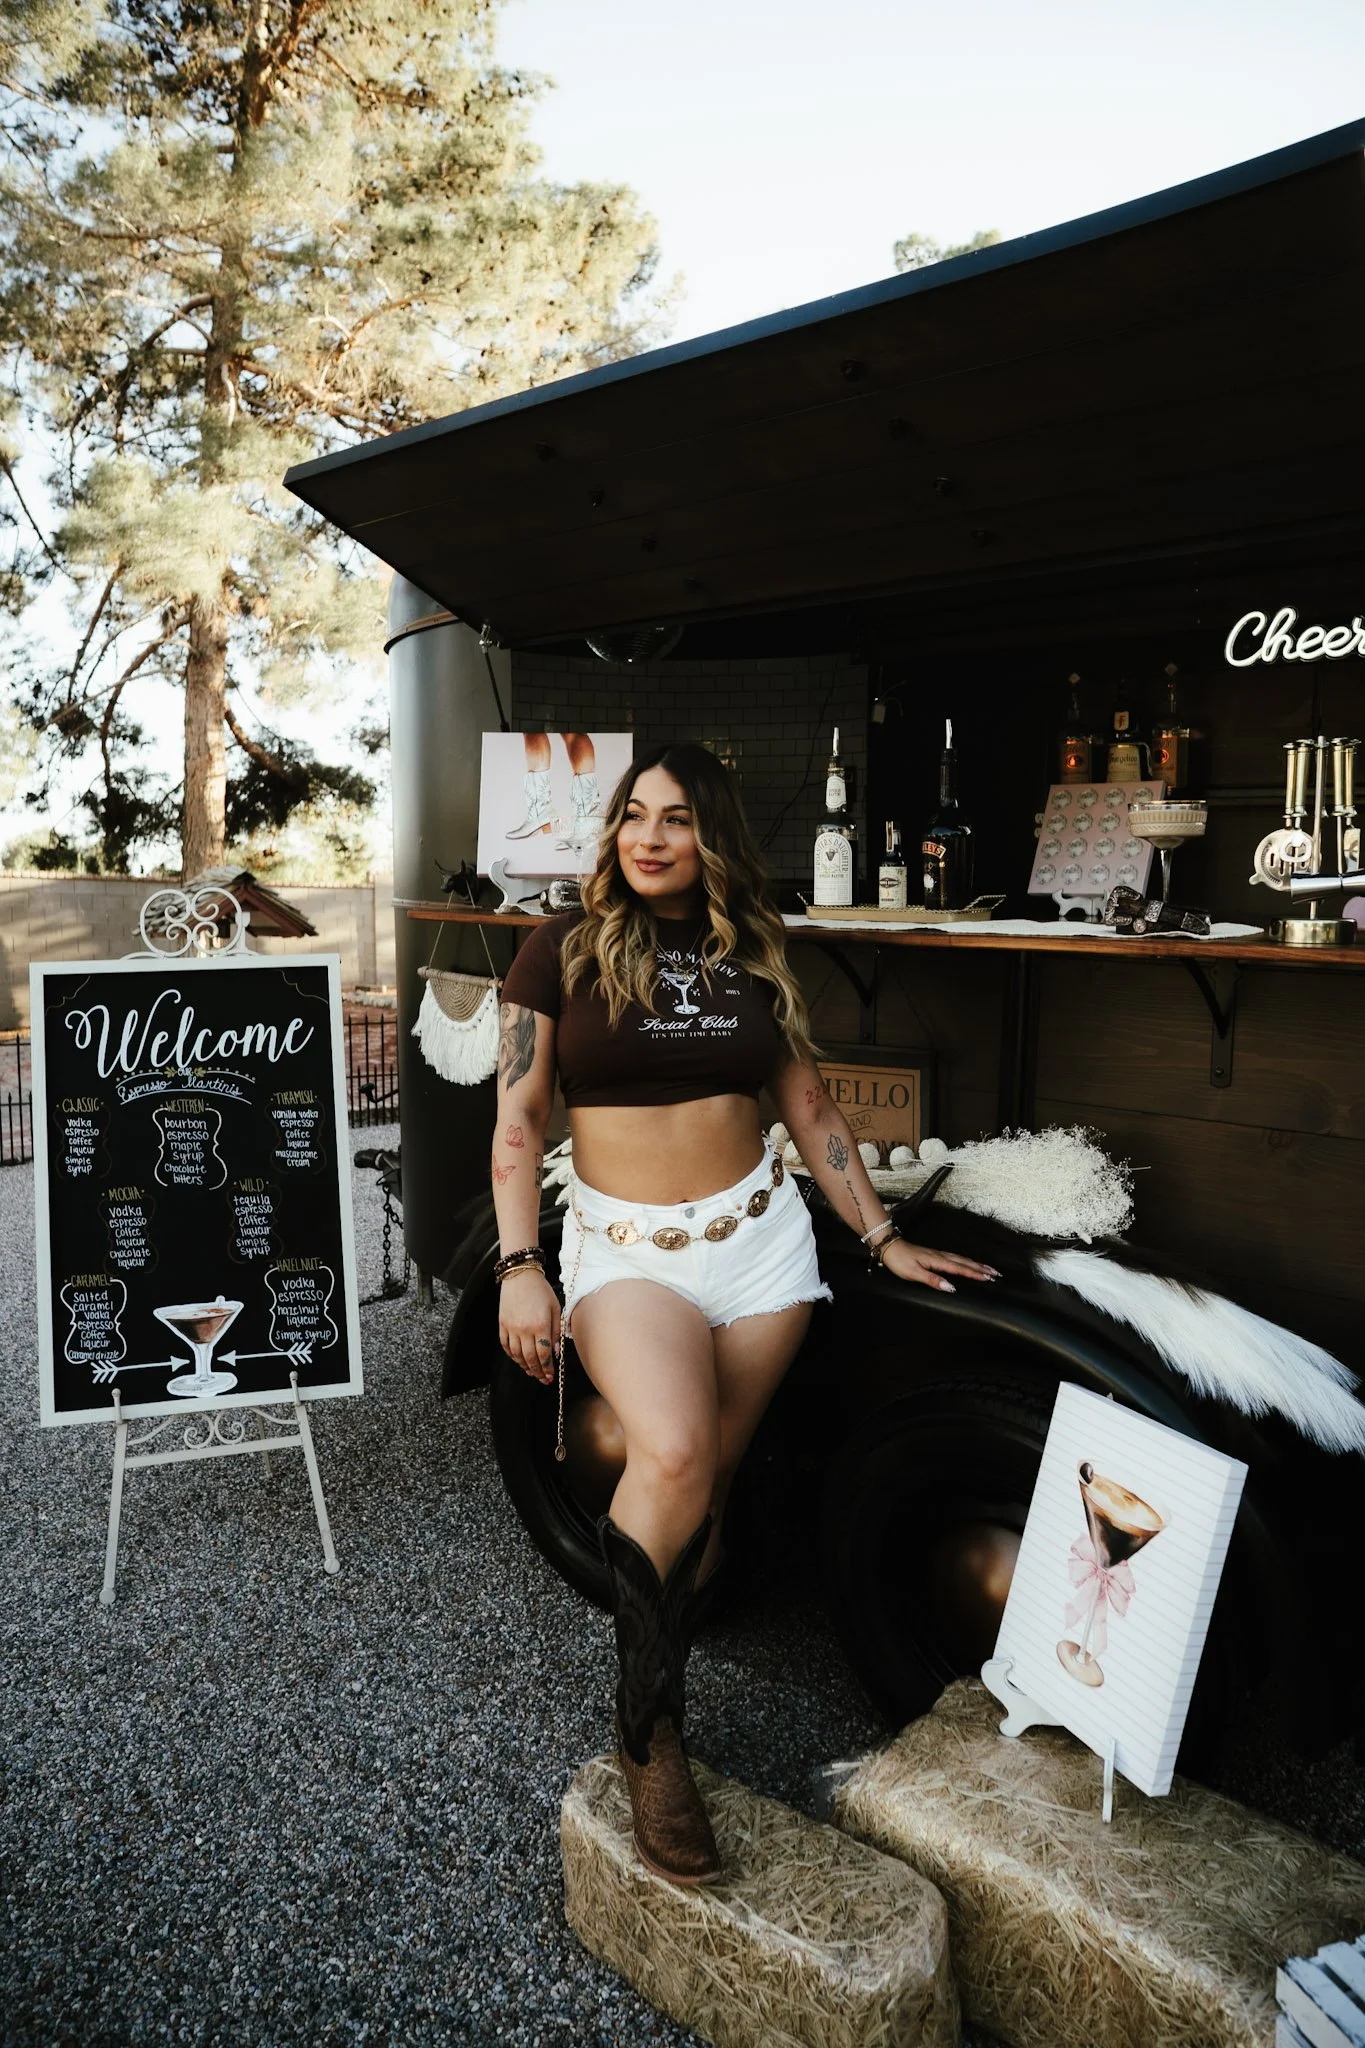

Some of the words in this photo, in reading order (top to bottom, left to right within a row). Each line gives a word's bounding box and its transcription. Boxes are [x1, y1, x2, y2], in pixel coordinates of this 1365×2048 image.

[924, 843, 941, 855] LEYS
[638, 1018, 693, 1031] Social
[698, 1015, 739, 1029] Club
[65, 989, 315, 1079] Welcome
[118, 1080, 172, 1102] Espresso
[181, 1076, 243, 1096] Martinis
[62, 1097, 100, 1112] CLASSIC
[164, 1117, 207, 1130] bourbon
[849, 1114, 872, 1129] AND
[166, 1131, 210, 1141] espresso
[170, 1141, 202, 1153] maple
[238, 1178, 265, 1192] WILD
[108, 1186, 142, 1201] MOCHA
[233, 1194, 271, 1206] tequila
[235, 1205, 273, 1217] espresso
[109, 1217, 148, 1229] espresso
[70, 1274, 112, 1288] CARAMEL
[281, 1276, 315, 1291] vodka
[278, 1290, 324, 1303] espresso
[277, 1305, 320, 1316] hazelnut
[77, 1321, 115, 1330] espresso
